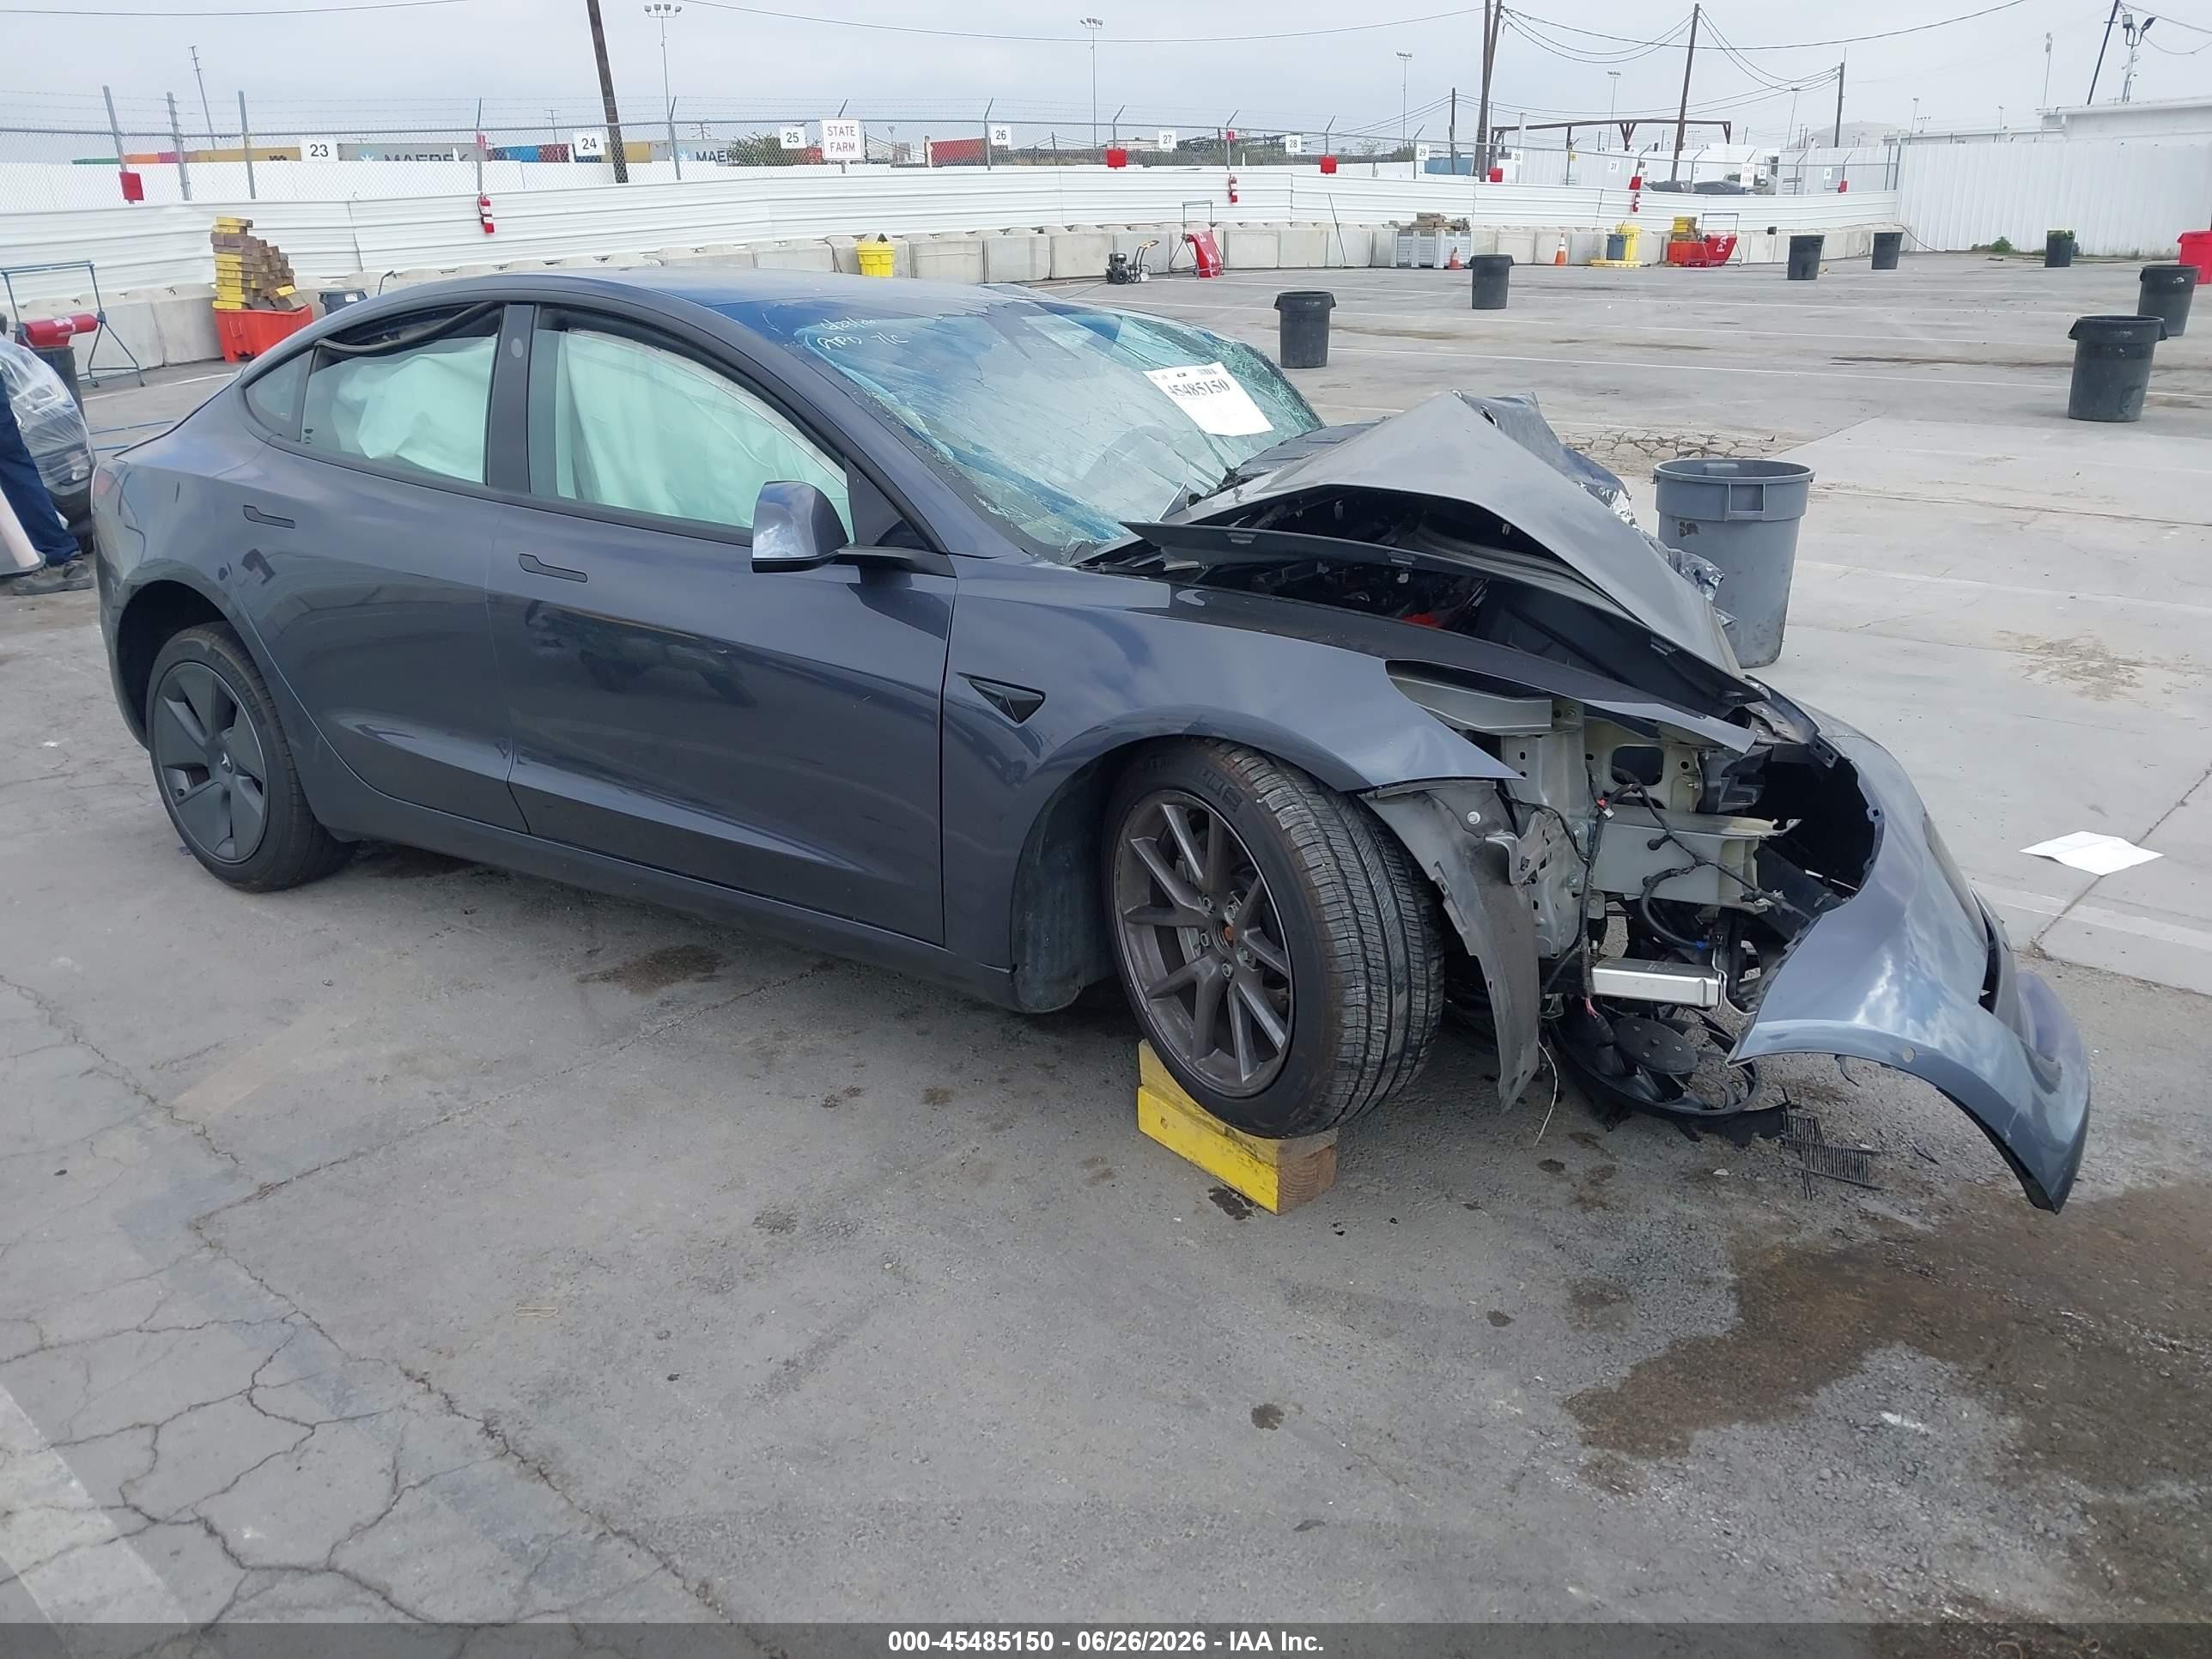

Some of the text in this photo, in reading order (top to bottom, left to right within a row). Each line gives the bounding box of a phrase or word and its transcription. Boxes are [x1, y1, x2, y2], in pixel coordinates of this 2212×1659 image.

[827, 126, 856, 137] STATE
[995, 130, 1007, 140] 26
[786, 132, 799, 143] 25
[1163, 134, 1173, 144] 27
[580, 137, 598, 150] 24
[830, 142, 856, 152] FARM
[1289, 139, 1297, 149] 28
[309, 143, 329, 157] 23
[1167, 378, 1231, 397] 45485150
